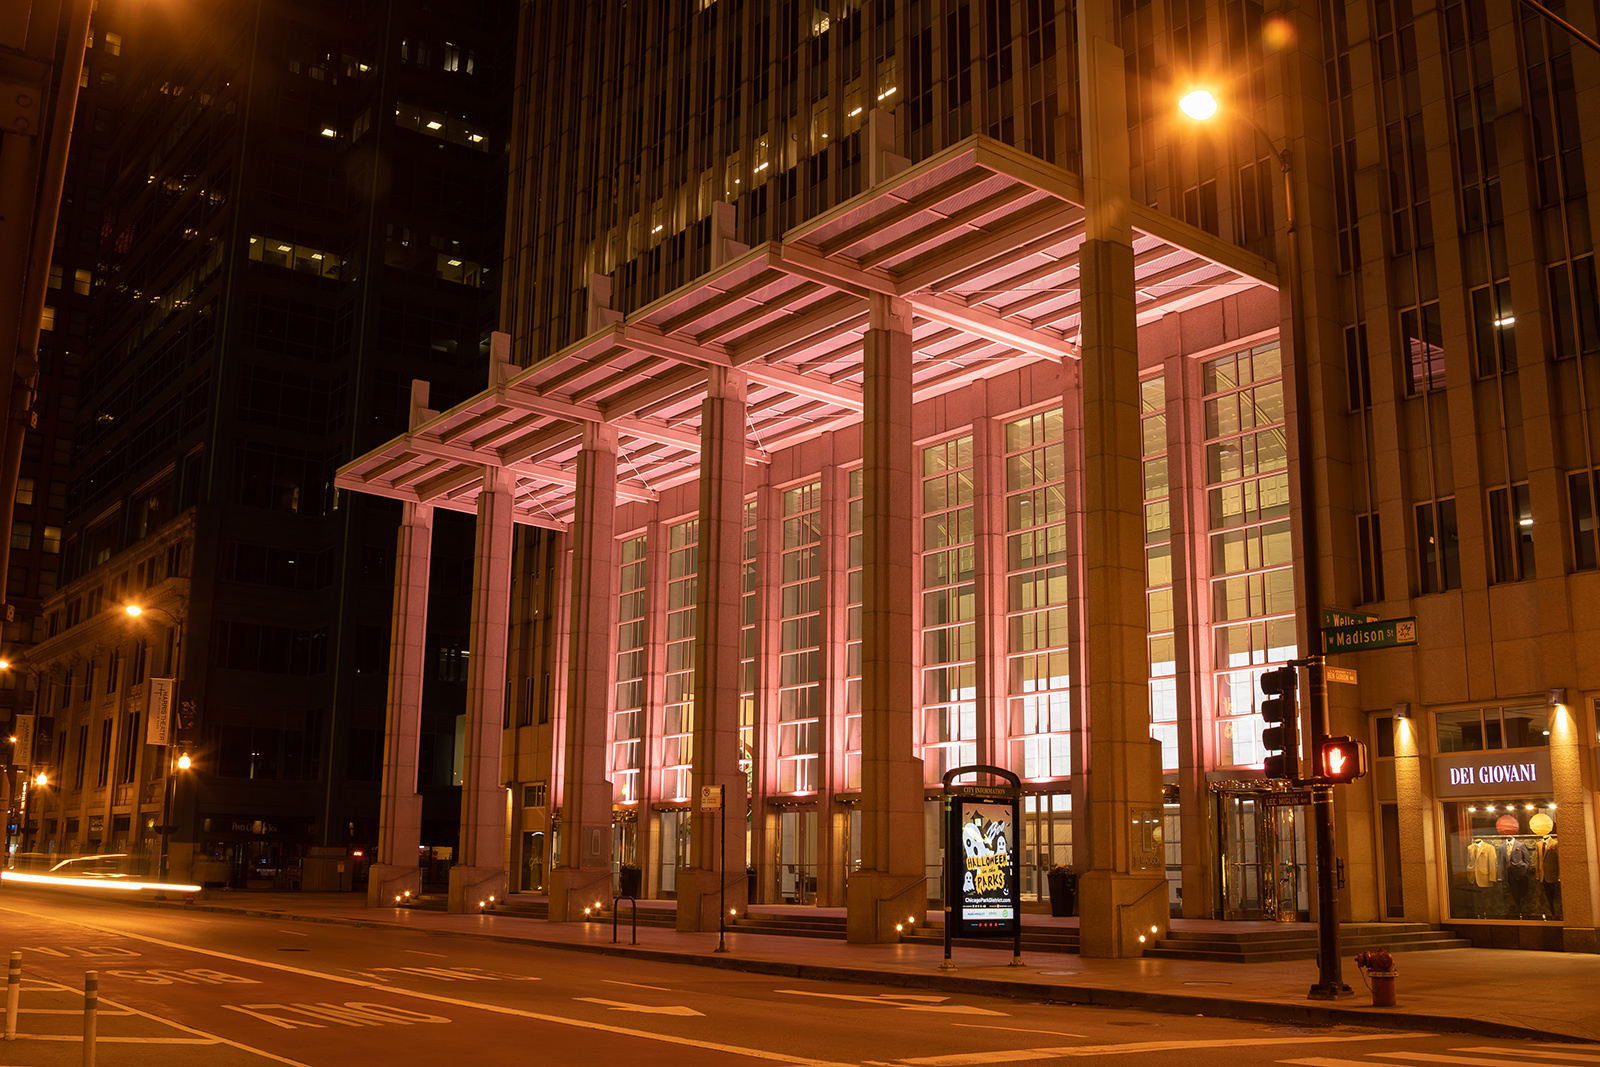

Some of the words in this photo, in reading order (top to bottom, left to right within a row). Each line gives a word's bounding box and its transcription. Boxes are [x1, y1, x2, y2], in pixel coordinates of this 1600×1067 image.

[1333, 614, 1355, 627] Wells
[1336, 629, 1384, 646] Madison
[1386, 629, 1394, 637] St
[158, 714, 167, 741] THEATER
[1450, 766, 1475, 785] DEI
[1478, 763, 1537, 784] GIOVANI
[963, 786, 974, 794] CITY
[974, 787, 1006, 795] INFORMATION
[1265, 798, 1277, 806] LEE
[1278, 797, 1299, 805] MIGLIN
[967, 853, 1007, 868] HALLOWEEN
[977, 873, 1004, 889] PARKS
[105, 968, 263, 985] BUS
[220, 1001, 452, 1029] ONLY
